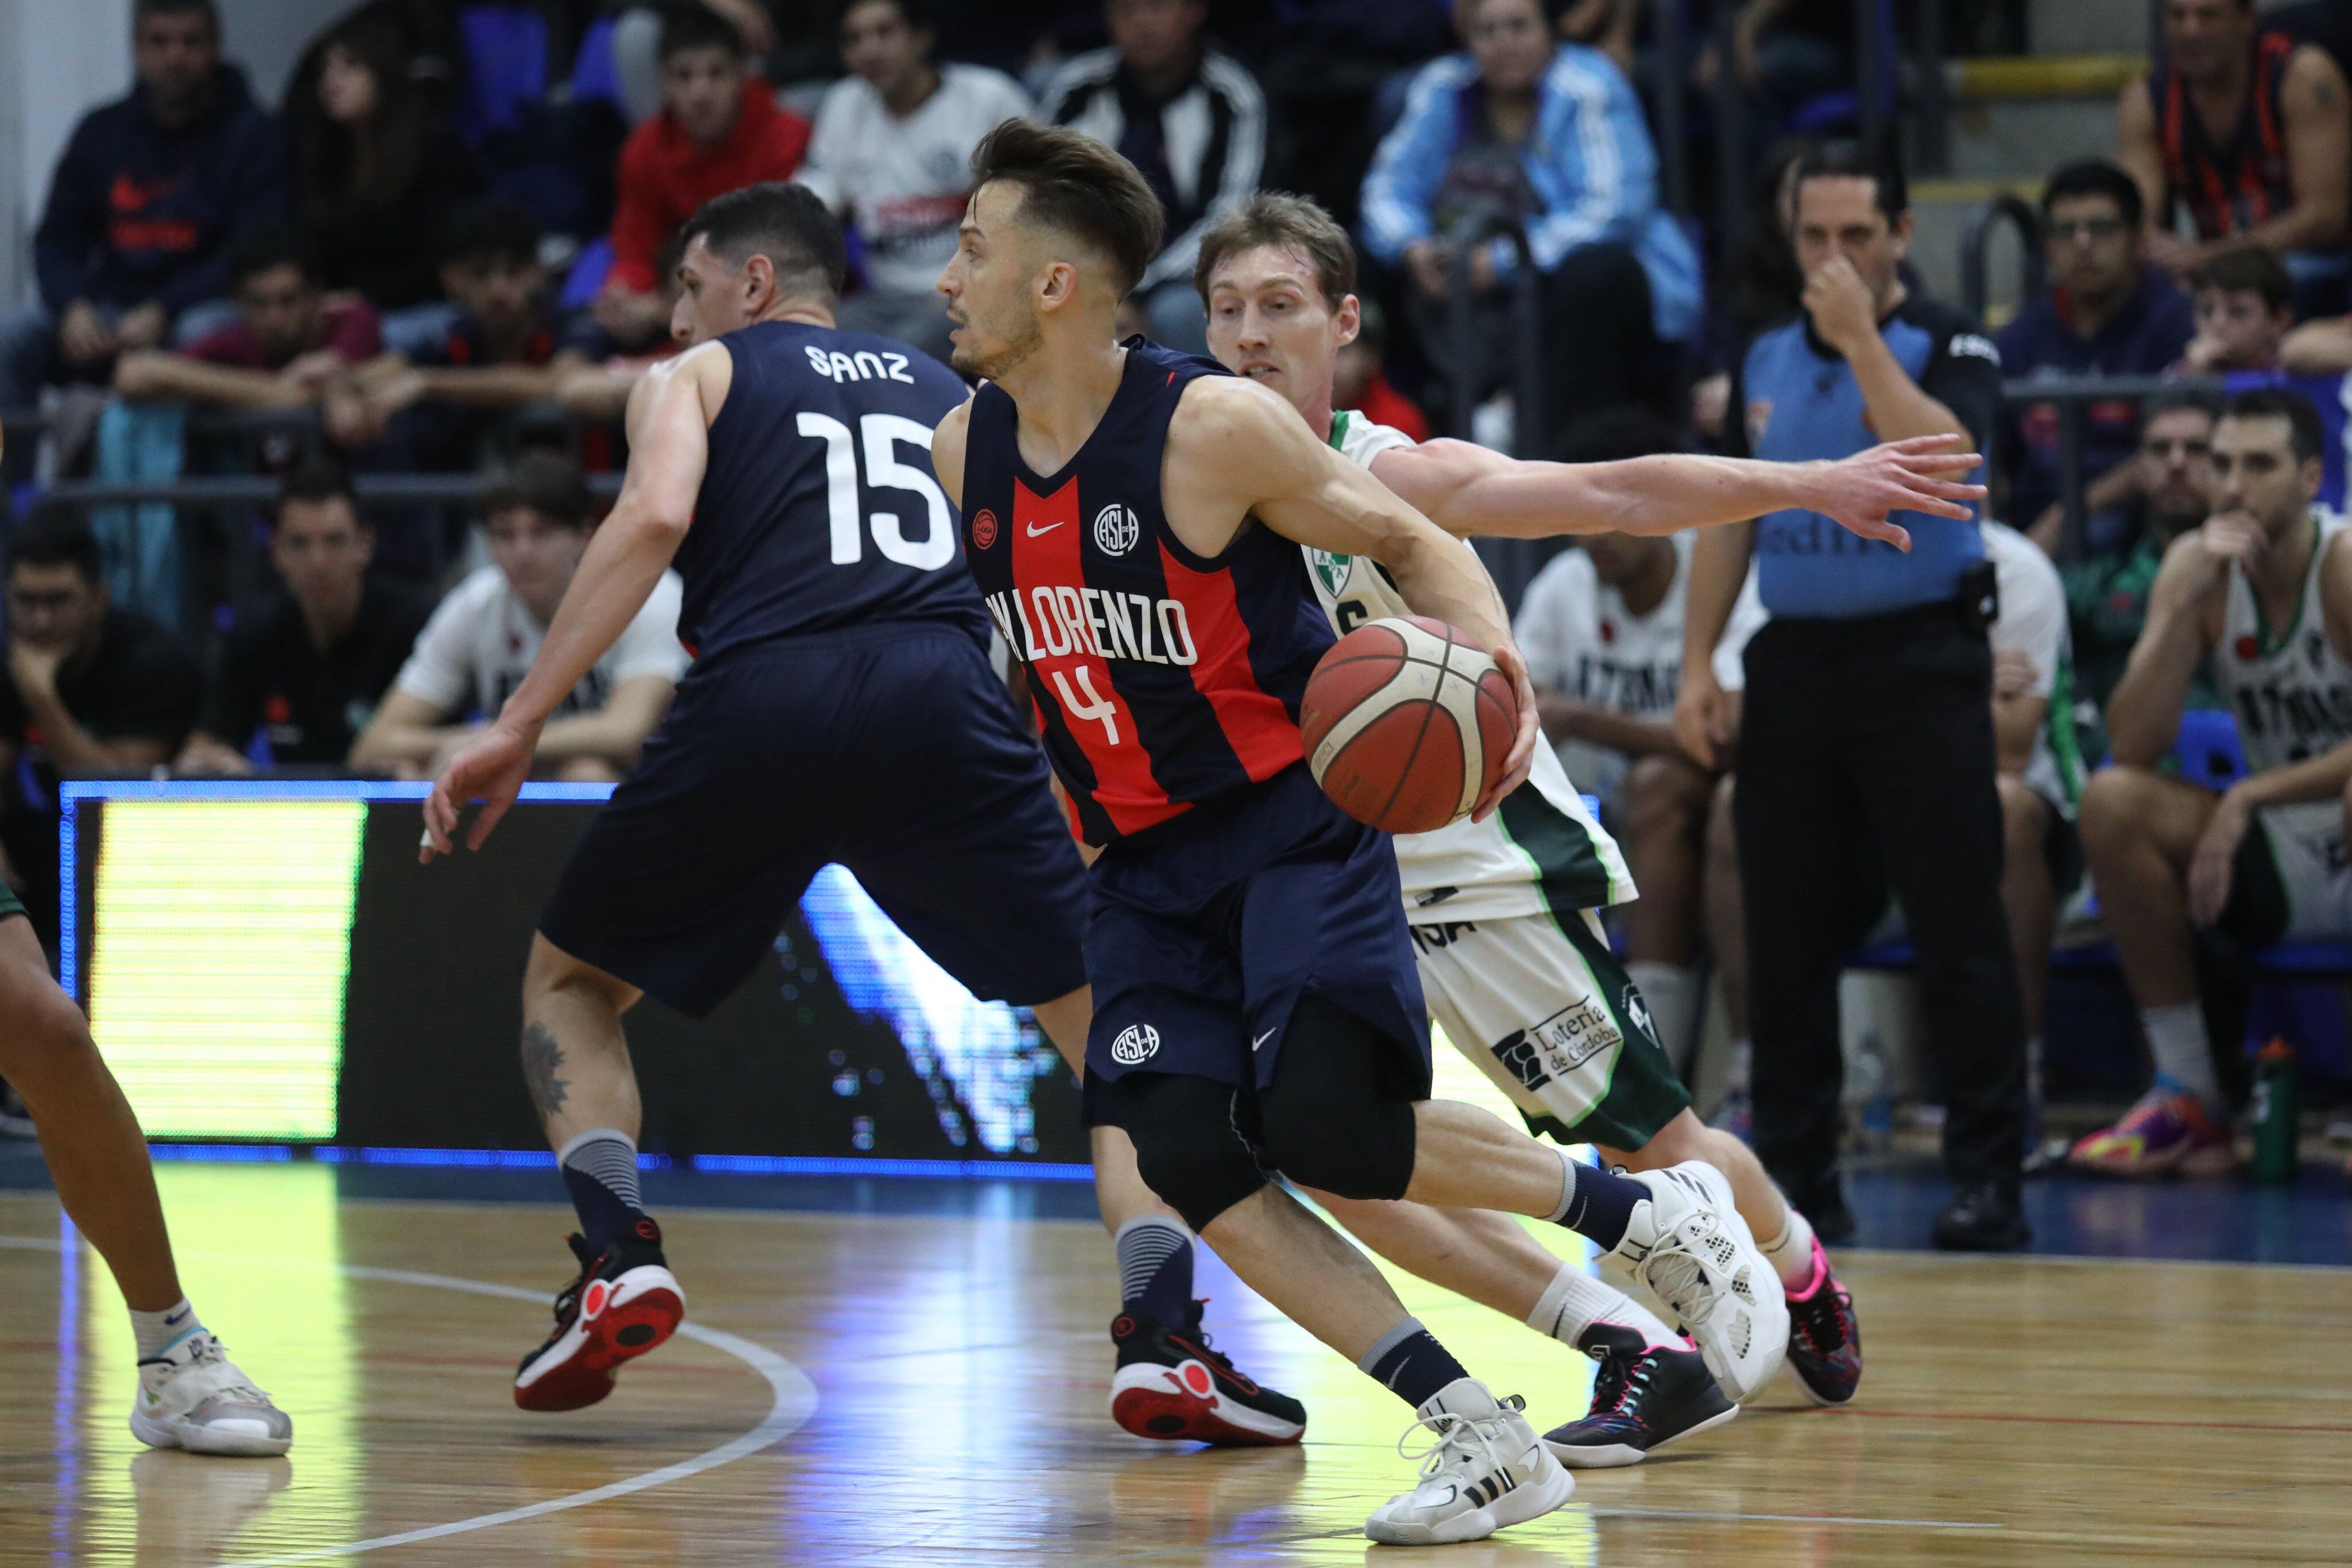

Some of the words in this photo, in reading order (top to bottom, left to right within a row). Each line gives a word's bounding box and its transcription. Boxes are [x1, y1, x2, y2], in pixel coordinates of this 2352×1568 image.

[804, 345, 914, 384] SANZ
[796, 411, 956, 571] 15
[1012, 586, 1198, 665] LORENZO
[1051, 665, 1120, 746] 4
[1551, 1055, 1568, 1070] de
